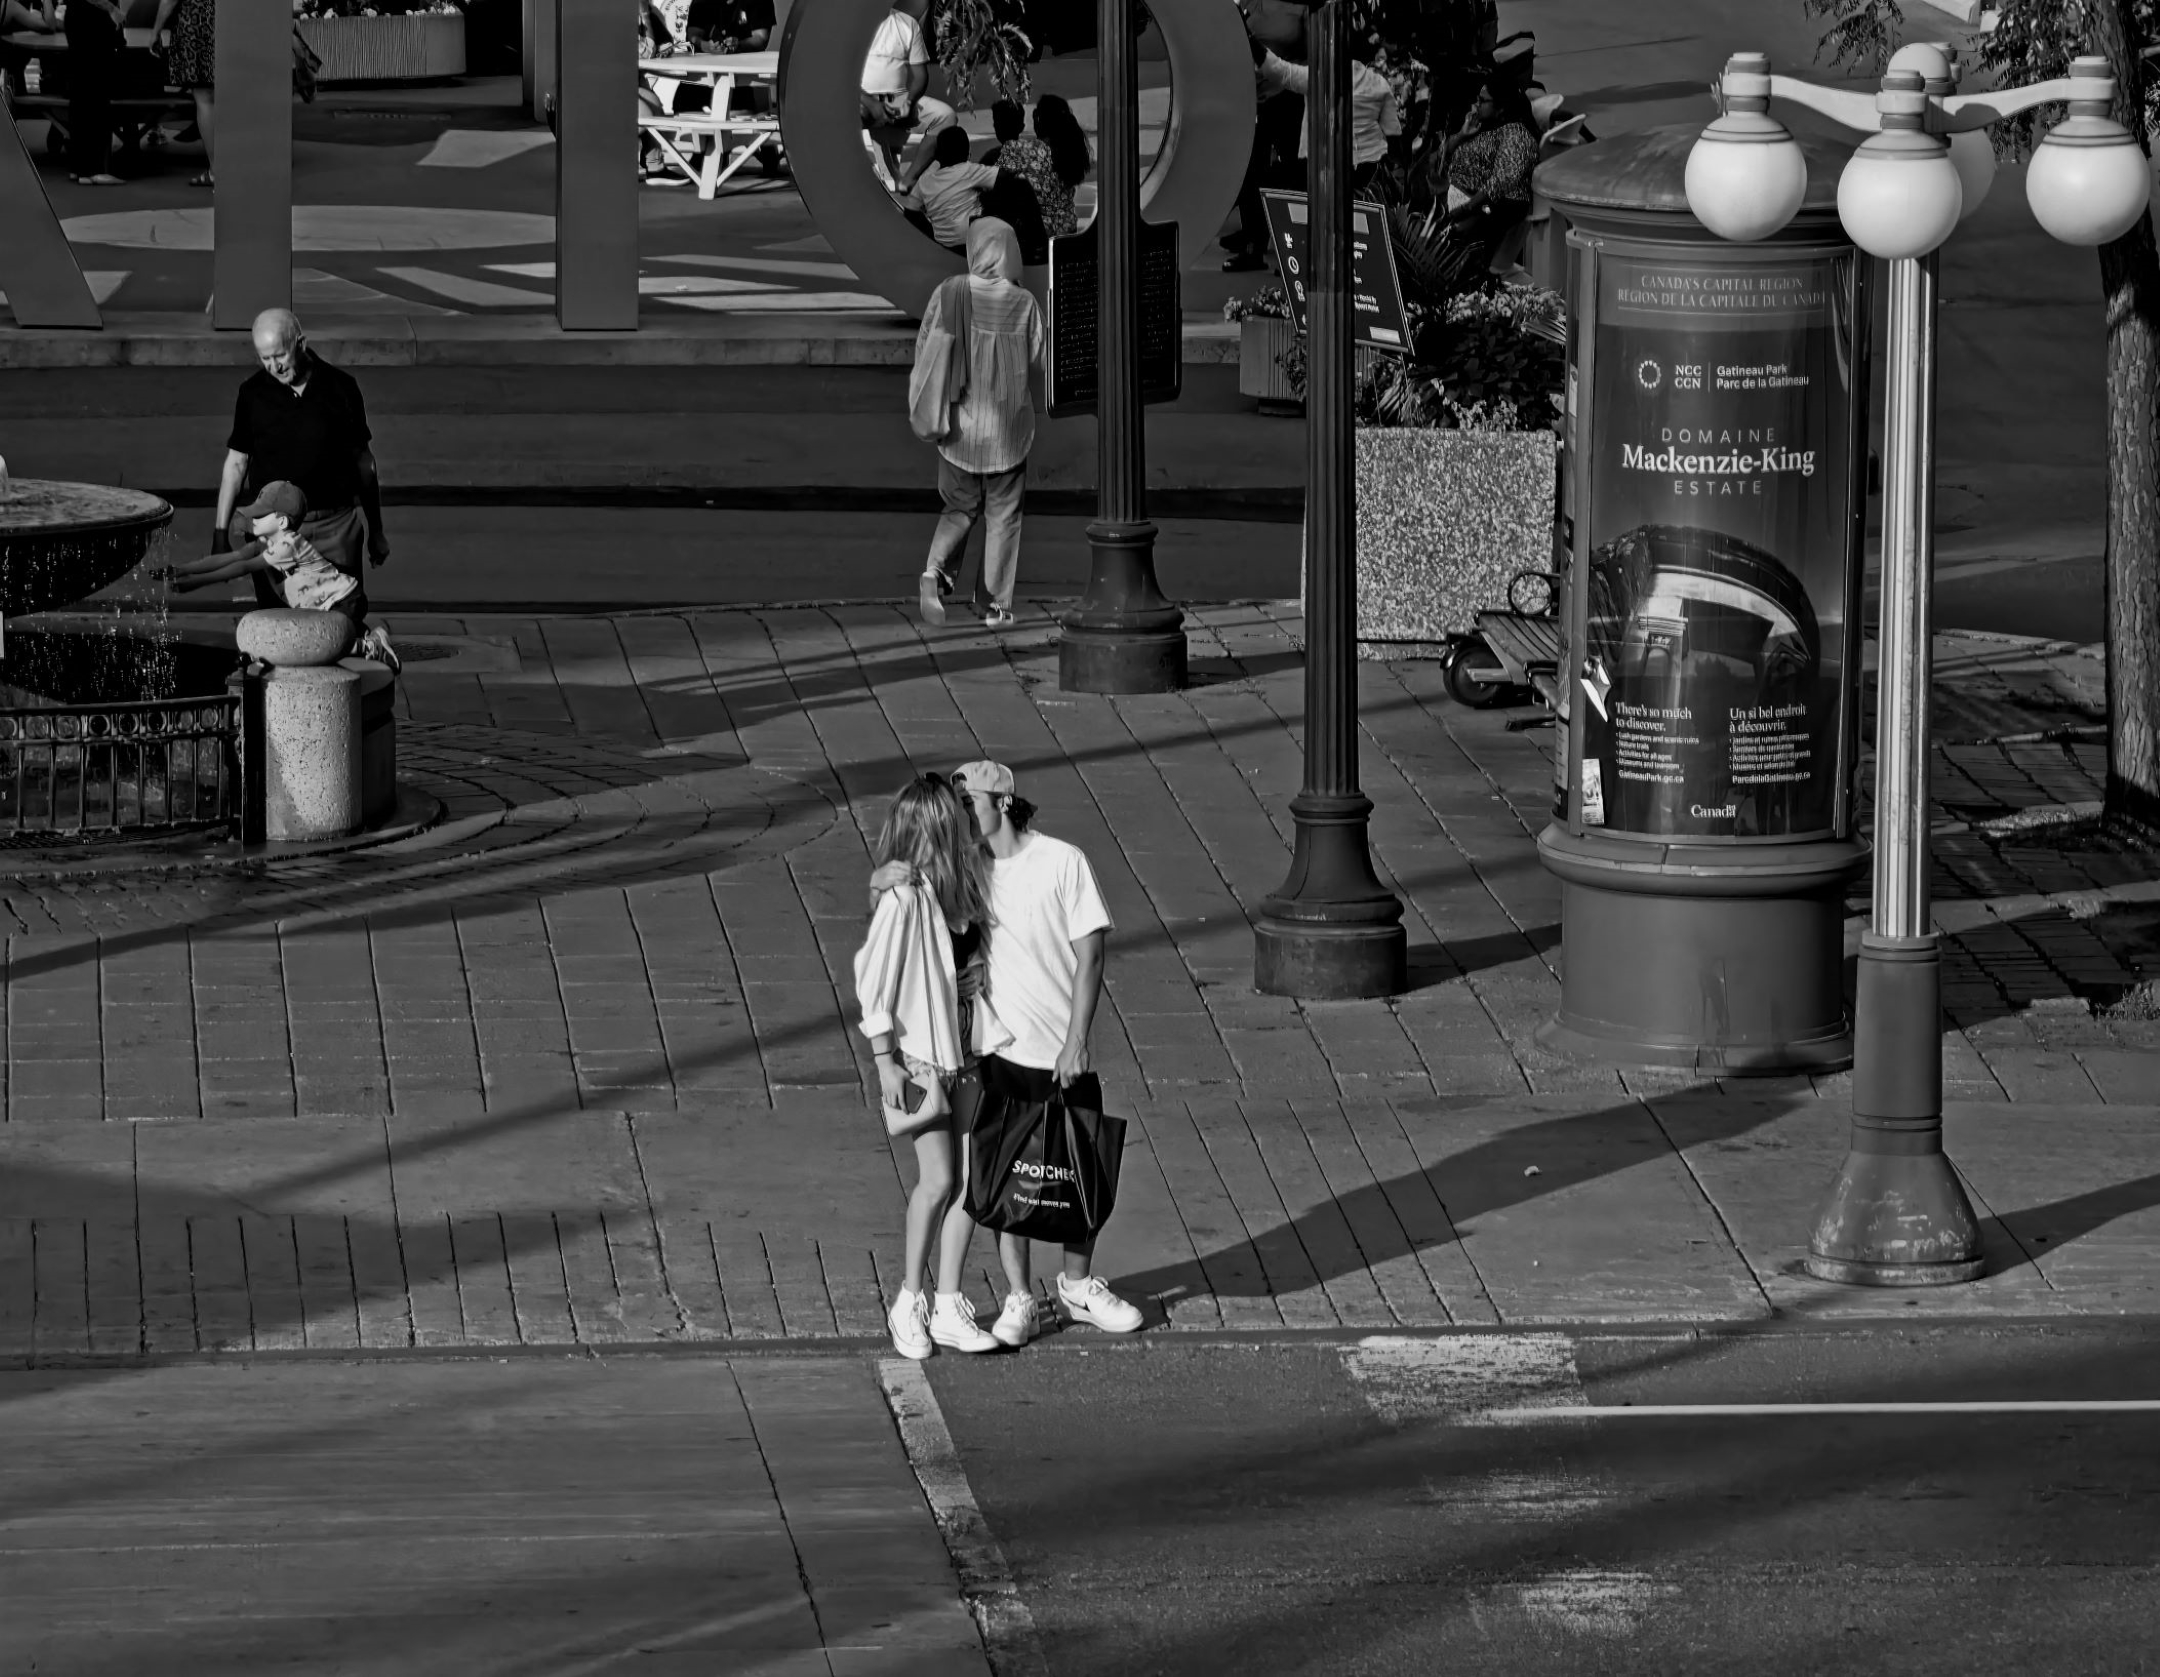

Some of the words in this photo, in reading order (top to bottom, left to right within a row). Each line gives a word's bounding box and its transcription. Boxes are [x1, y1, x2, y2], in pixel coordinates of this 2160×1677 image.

[1641, 275, 1700, 292] CANADA'S
[1703, 277, 1754, 291] CAPITAL
[1760, 276, 1804, 291] REGION
[1661, 292, 1676, 306] DE
[1681, 293, 1696, 308] LA
[1699, 293, 1759, 308] CAPITALE
[1675, 365, 1702, 377] NCC
[1717, 365, 1764, 377] Gatineau
[1766, 363, 1788, 376] Park
[1674, 377, 1702, 389] CCN
[1716, 378, 1741, 390] Parc
[1742, 378, 1756, 389] de
[1758, 377, 1767, 389] la
[1768, 375, 1809, 387] Gatineau
[1661, 428, 1775, 444] DOMAINE
[1622, 443, 1815, 477] Mackenzie-King
[1674, 480, 1762, 496] ESTATE
[1615, 701, 1648, 718] There's
[1649, 707, 1660, 719] so
[1662, 706, 1692, 720] much
[1729, 707, 1746, 720] Un
[1748, 706, 1757, 720] si
[1759, 705, 1773, 719] bel
[1775, 703, 1807, 719] endroit
[1616, 717, 1625, 728] to
[1626, 716, 1666, 732] discover.
[1729, 720, 1736, 734] à
[1691, 804, 1736, 818] Canada
